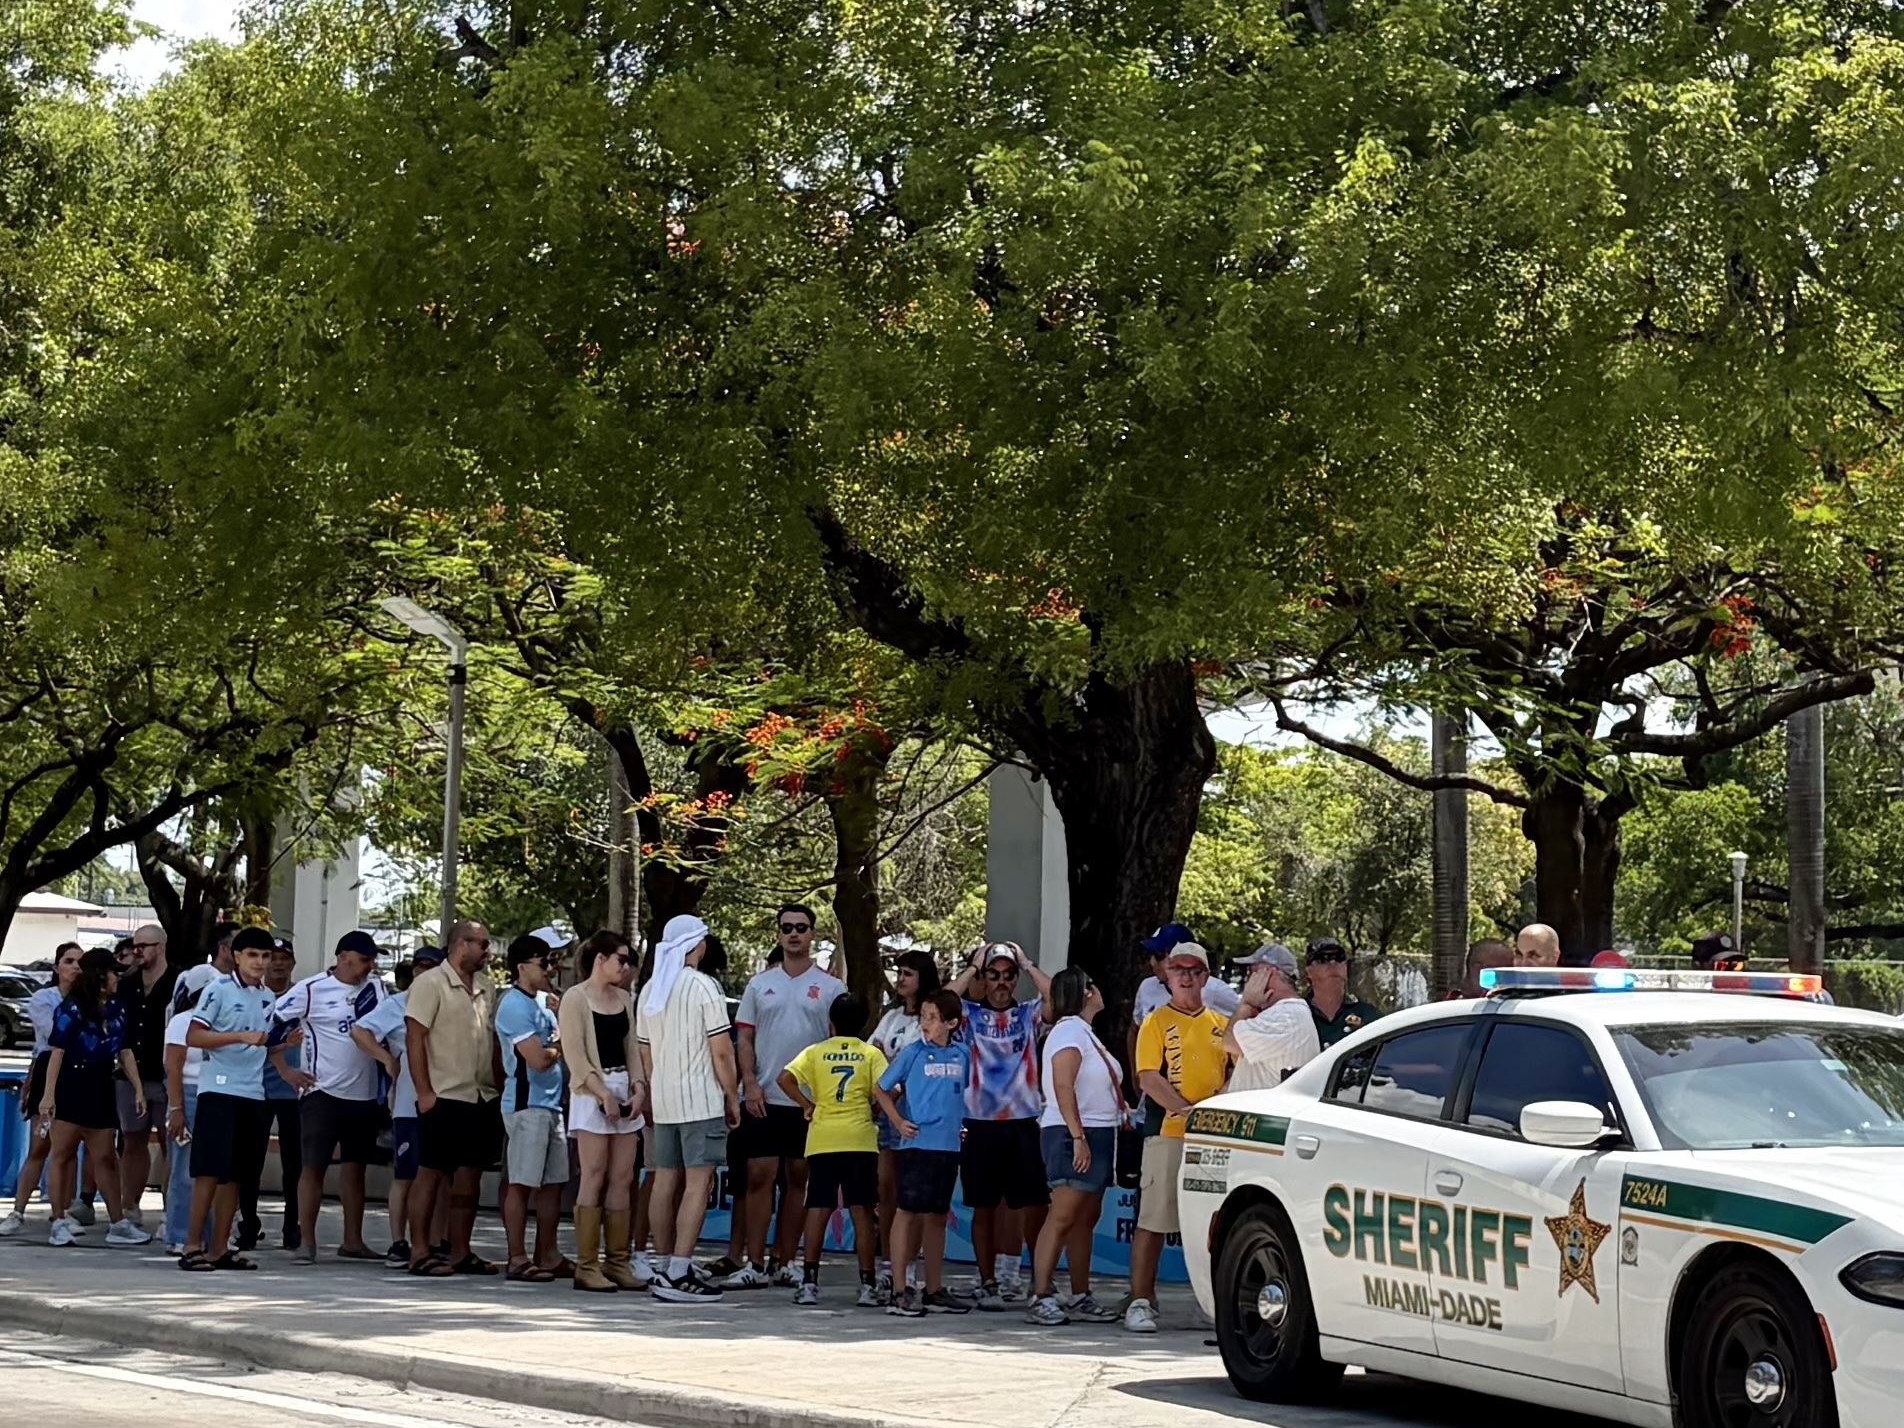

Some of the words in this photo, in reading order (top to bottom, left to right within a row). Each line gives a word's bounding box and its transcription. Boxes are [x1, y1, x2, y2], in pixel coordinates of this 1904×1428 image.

[831, 1065, 855, 1103] 7
[1624, 1180, 1668, 1207] 7524A
[1322, 1182, 1533, 1292] SHERIFF
[1363, 1274, 1503, 1331] MIAMI-DADE
